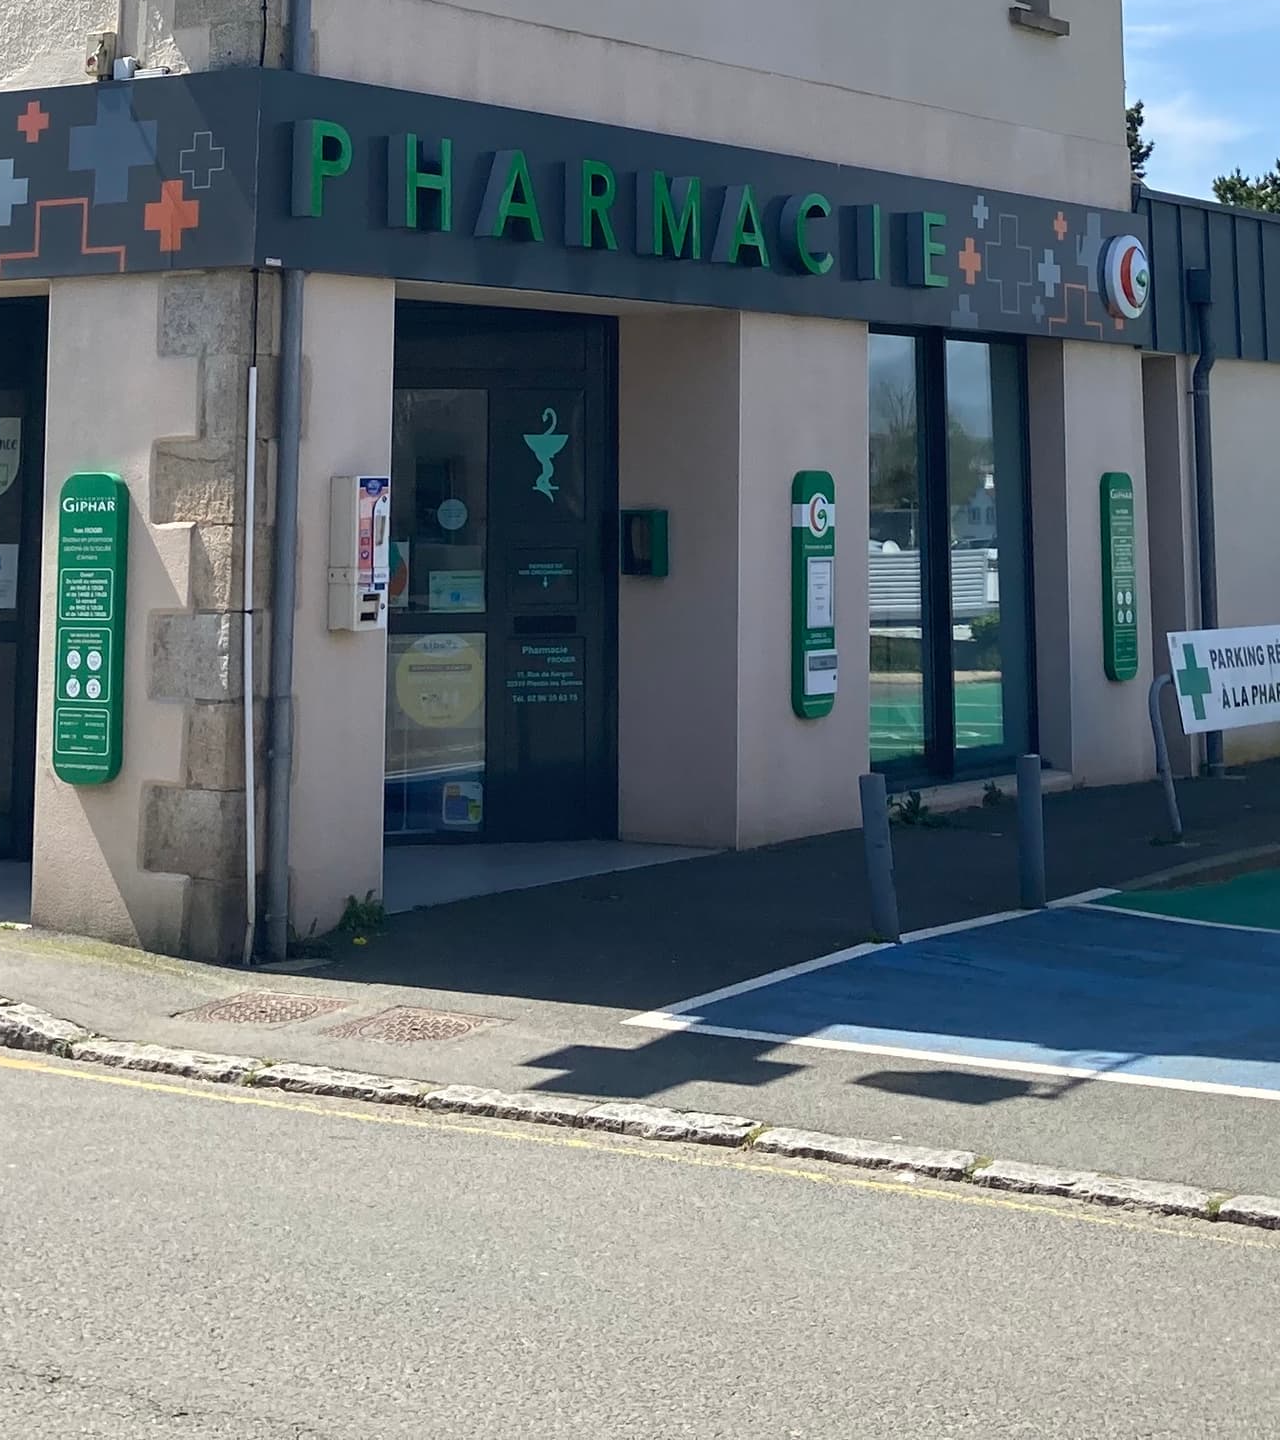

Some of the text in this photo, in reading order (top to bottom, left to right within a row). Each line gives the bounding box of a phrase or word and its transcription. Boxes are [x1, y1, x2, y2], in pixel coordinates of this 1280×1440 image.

[310, 119, 950, 288] PHARMACIE
[63, 497, 115, 512] GIPHAR
[1209, 644, 1265, 670] PARKING
[1222, 683, 1231, 709] À
[1232, 685, 1250, 707] LA
